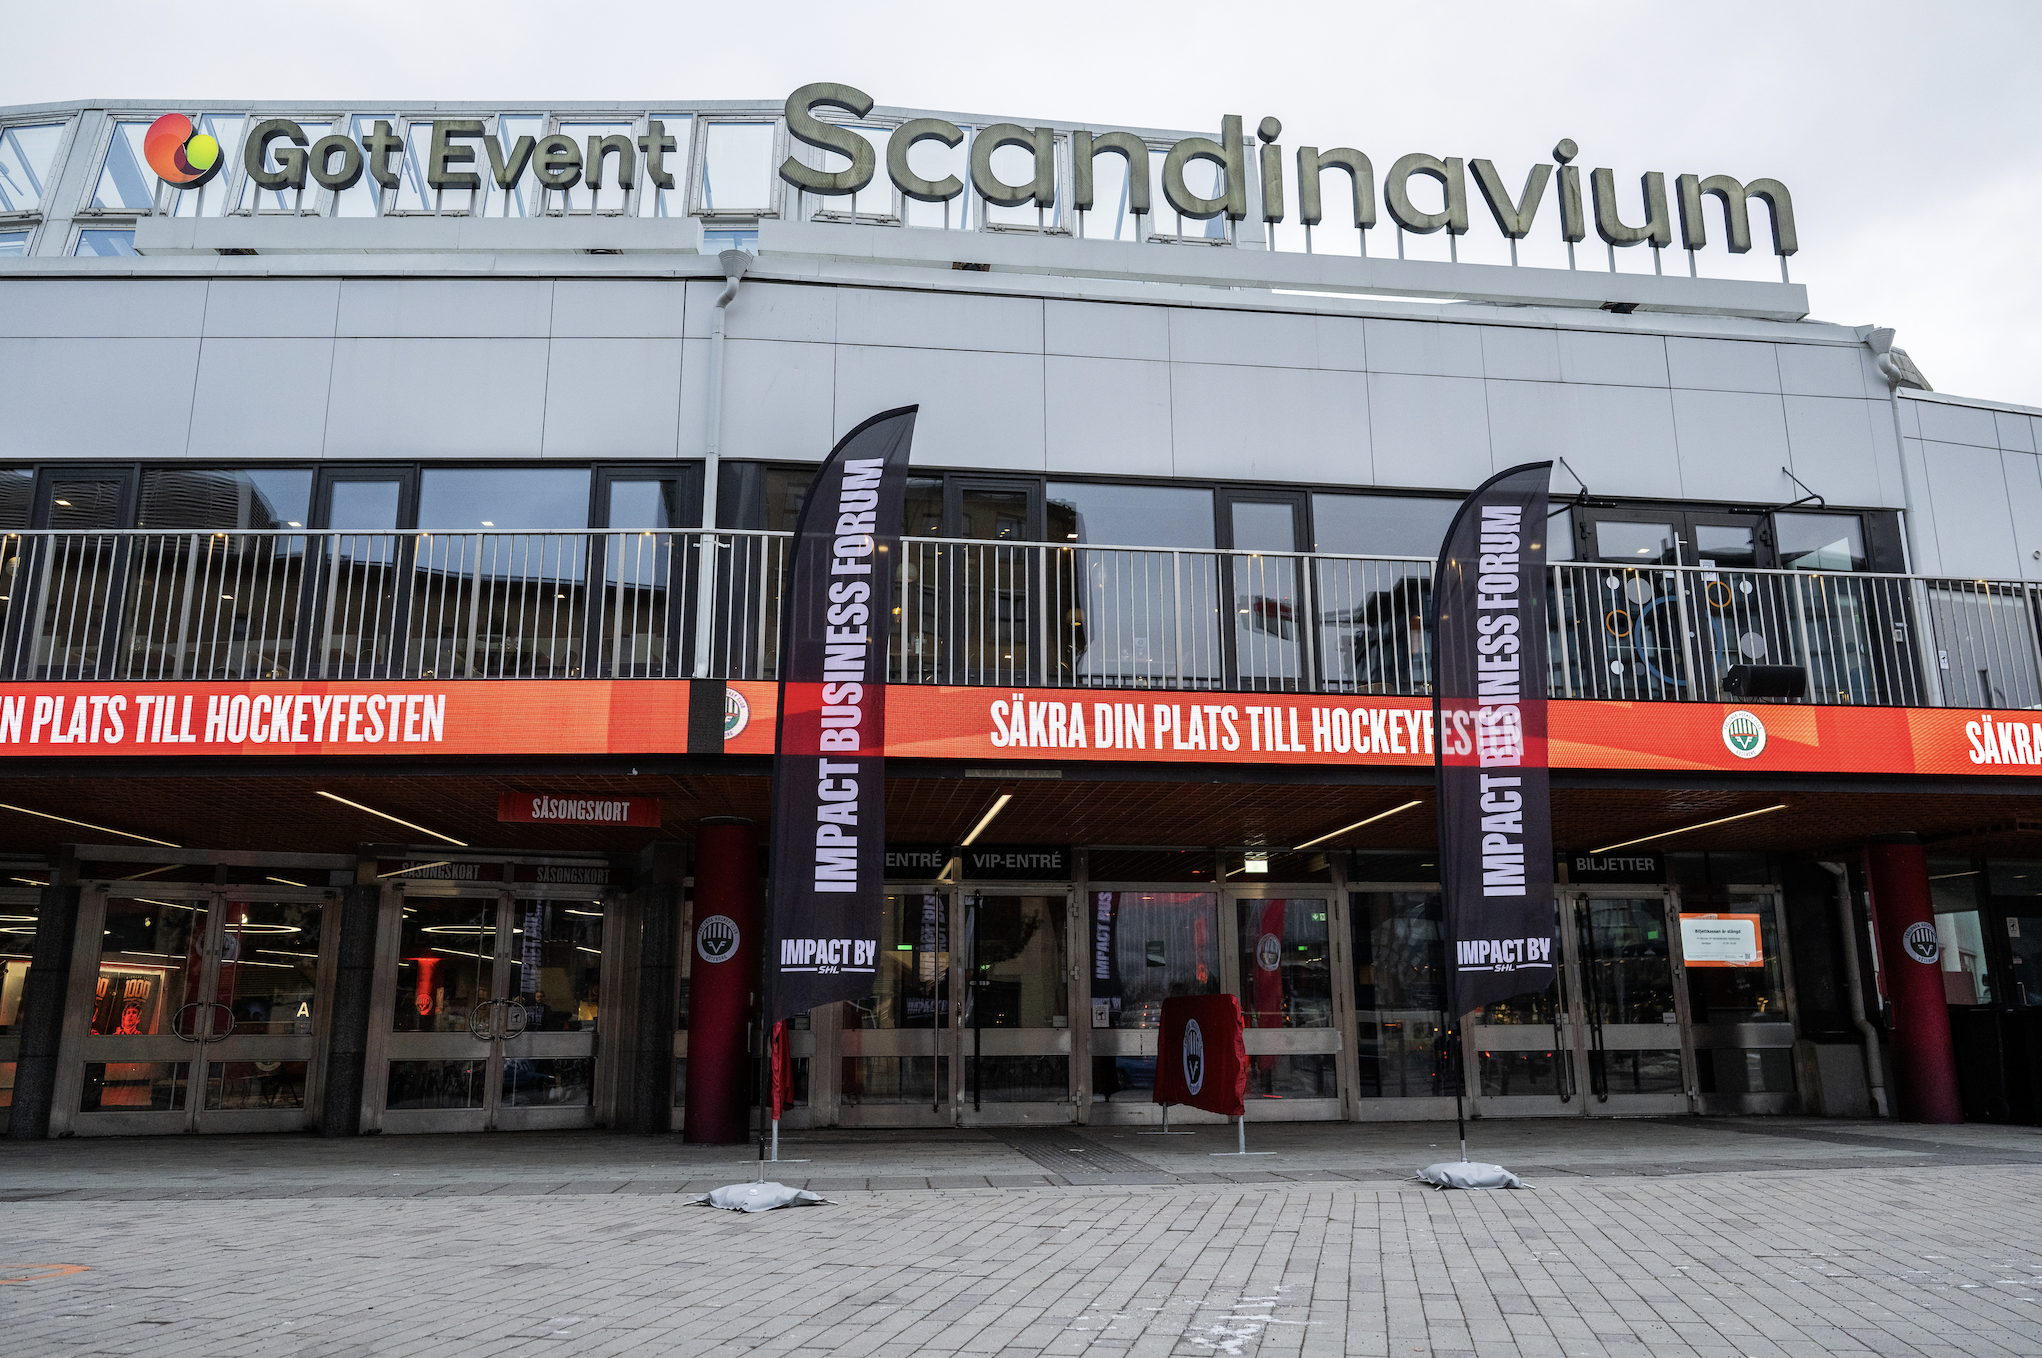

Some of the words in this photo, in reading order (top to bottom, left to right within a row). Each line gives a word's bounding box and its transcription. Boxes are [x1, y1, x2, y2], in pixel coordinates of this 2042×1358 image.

[244, 118, 403, 190] Got
[428, 119, 678, 190] Event
[778, 82, 1798, 256] Scandinavium
[831, 457, 885, 575] FORUM
[1478, 506, 1522, 609] FORUM
[820, 581, 871, 751] BUSINESS
[1477, 614, 1521, 768] BUSINESS
[0, 696, 26, 743] N
[29, 695, 127, 743] PLATS
[136, 695, 196, 743] TILL
[204, 694, 446, 744] HOCKEYFESTEN
[990, 693, 1088, 748] SÄKRA
[1094, 703, 1146, 749] DIN
[1153, 704, 1240, 752] PLATS
[1245, 706, 1306, 752] TILL
[531, 796, 630, 821] SÄSONGSKORT
[814, 758, 860, 892] IMPACT
[1480, 773, 1526, 897] IMPACT
[401, 862, 480, 880] SÄSONGSKORT
[973, 851, 1062, 868] VIP-ENTRÉ
[1576, 857, 1655, 871] BILJETTER
[537, 866, 610, 884] SÄSONGSKORT
[780, 939, 852, 965] IMPACT
[853, 939, 876, 965] BY
[1457, 939, 1524, 965] IMPACT
[1527, 937, 1551, 961] BY
[818, 965, 840, 975] SHL
[1494, 964, 1516, 973] SHL
[123, 978, 152, 1000] 1000
[296, 1001, 310, 1018] A
